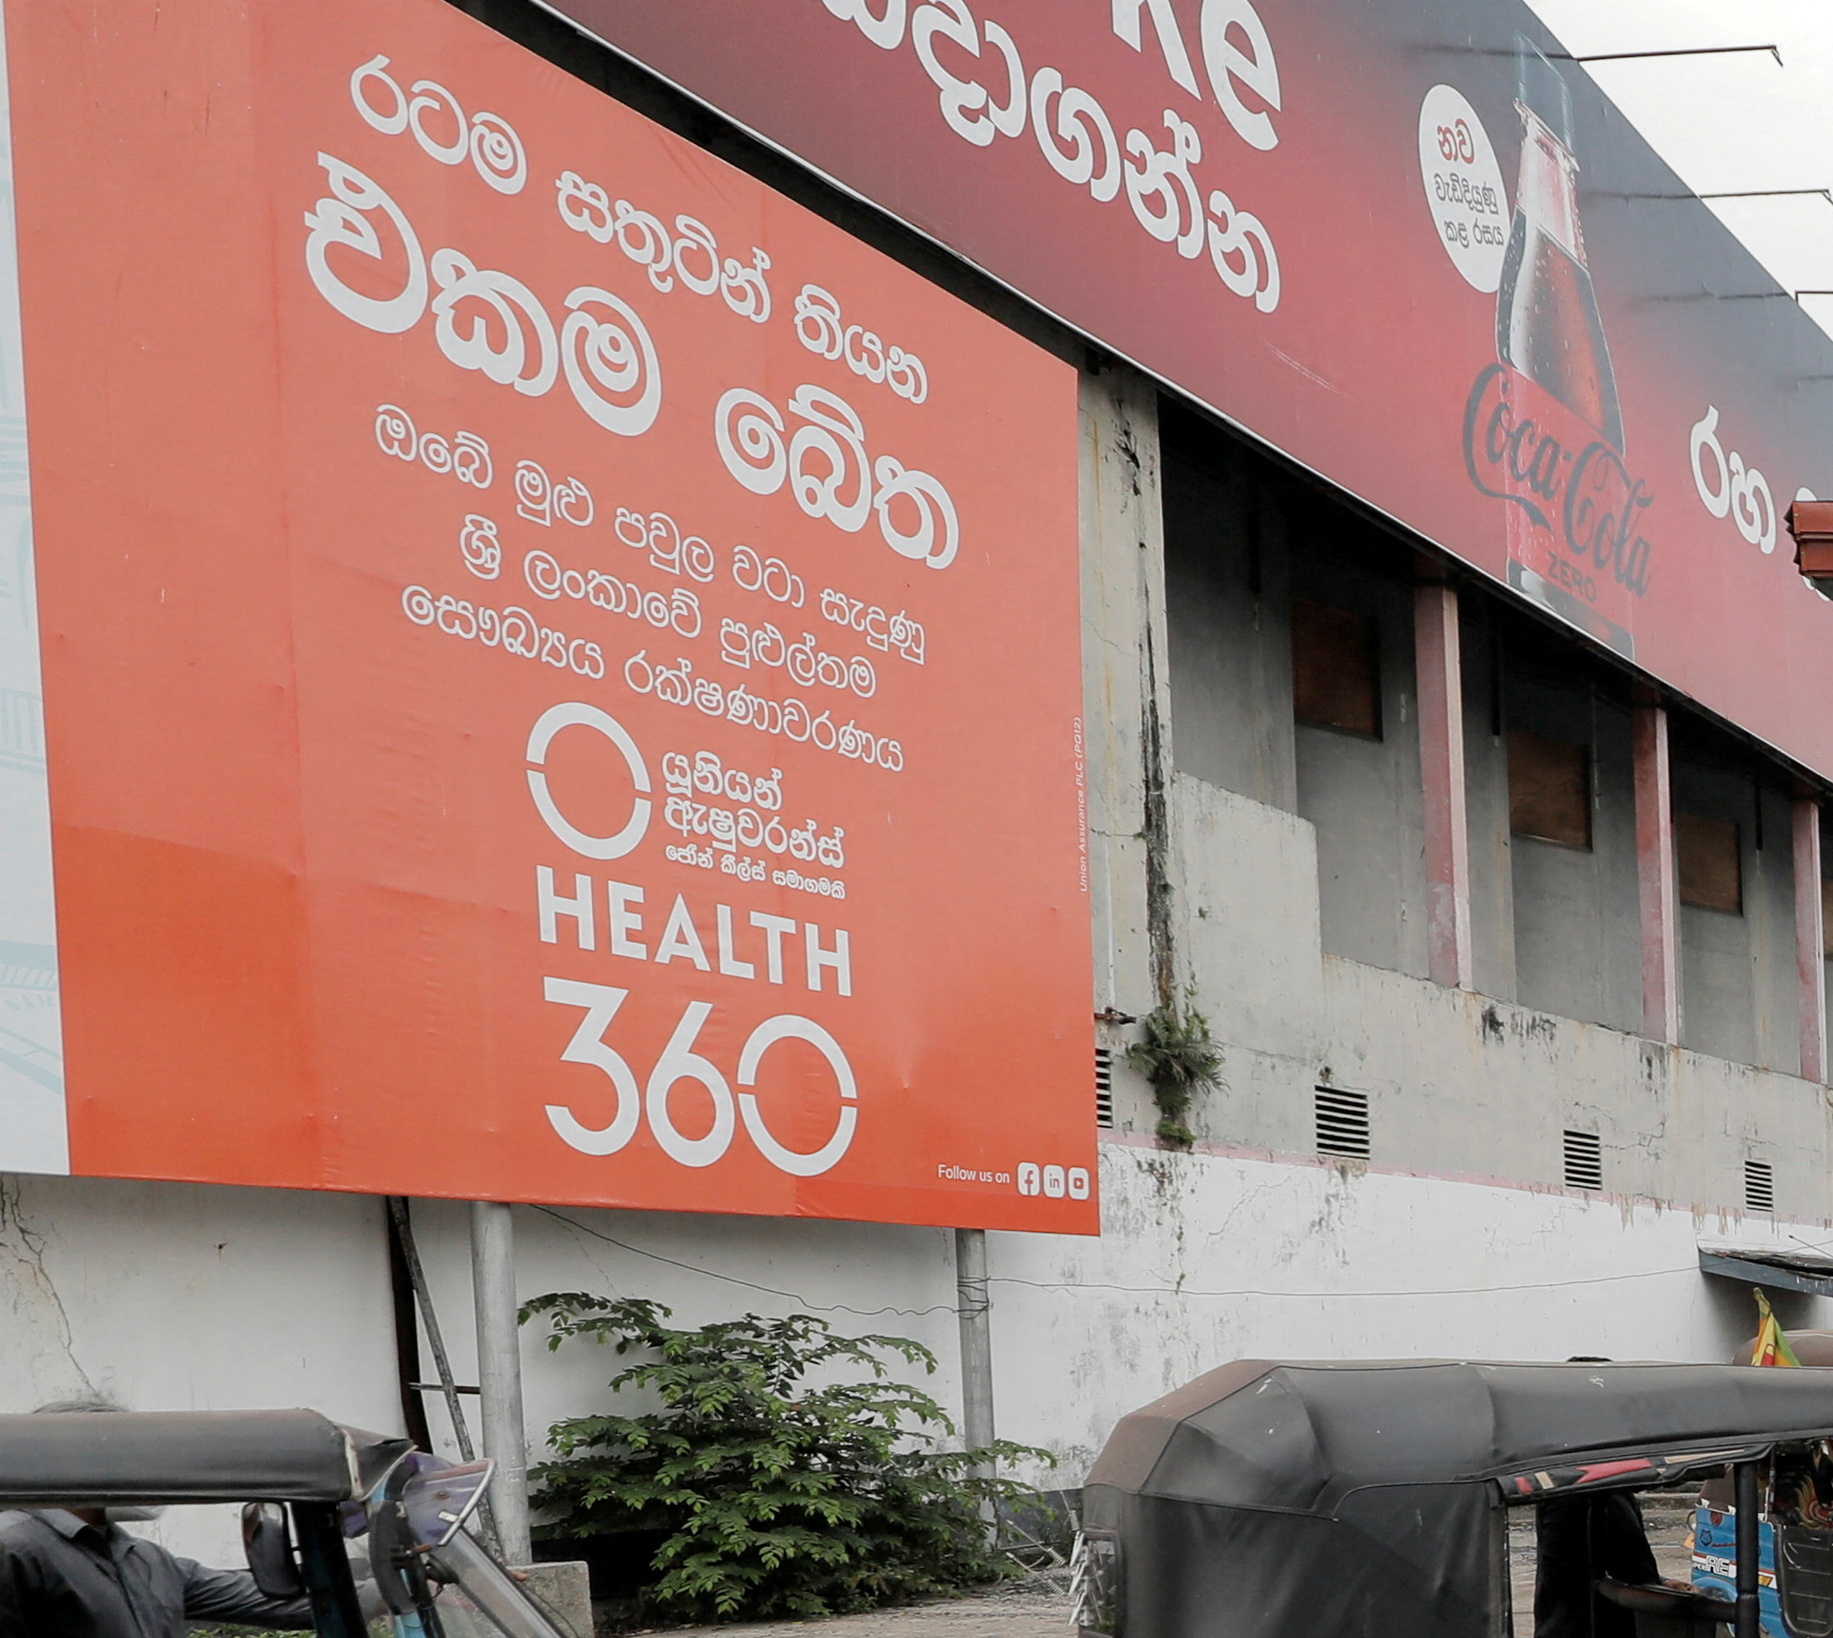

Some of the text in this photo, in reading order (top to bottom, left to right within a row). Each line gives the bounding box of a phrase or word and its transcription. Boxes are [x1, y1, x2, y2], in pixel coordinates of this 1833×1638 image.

[1437, 119, 1475, 164] නව
[351, 54, 928, 404] රටම සතුටින් තියන
[1444, 218, 1504, 248] කළ රසය
[303, 150, 959, 570] එකම බේත
[375, 404, 926, 665] ඔබේ මුළු පවුල වටා සැදුණු
[1690, 404, 1776, 554] රහ
[524, 550, 702, 638] ලංකාවේ
[719, 617, 877, 698] පුළුල්තම
[1547, 551, 1596, 602] ZERO
[623, 650, 904, 771] රක්ෂණාවරණය
[1075, 763, 1084, 787] PLC
[1078, 790, 1086, 853] Assurance
[536, 864, 852, 997] HEALTH
[543, 976, 858, 1177] 360
[937, 1164, 1010, 1184] Follow us on
